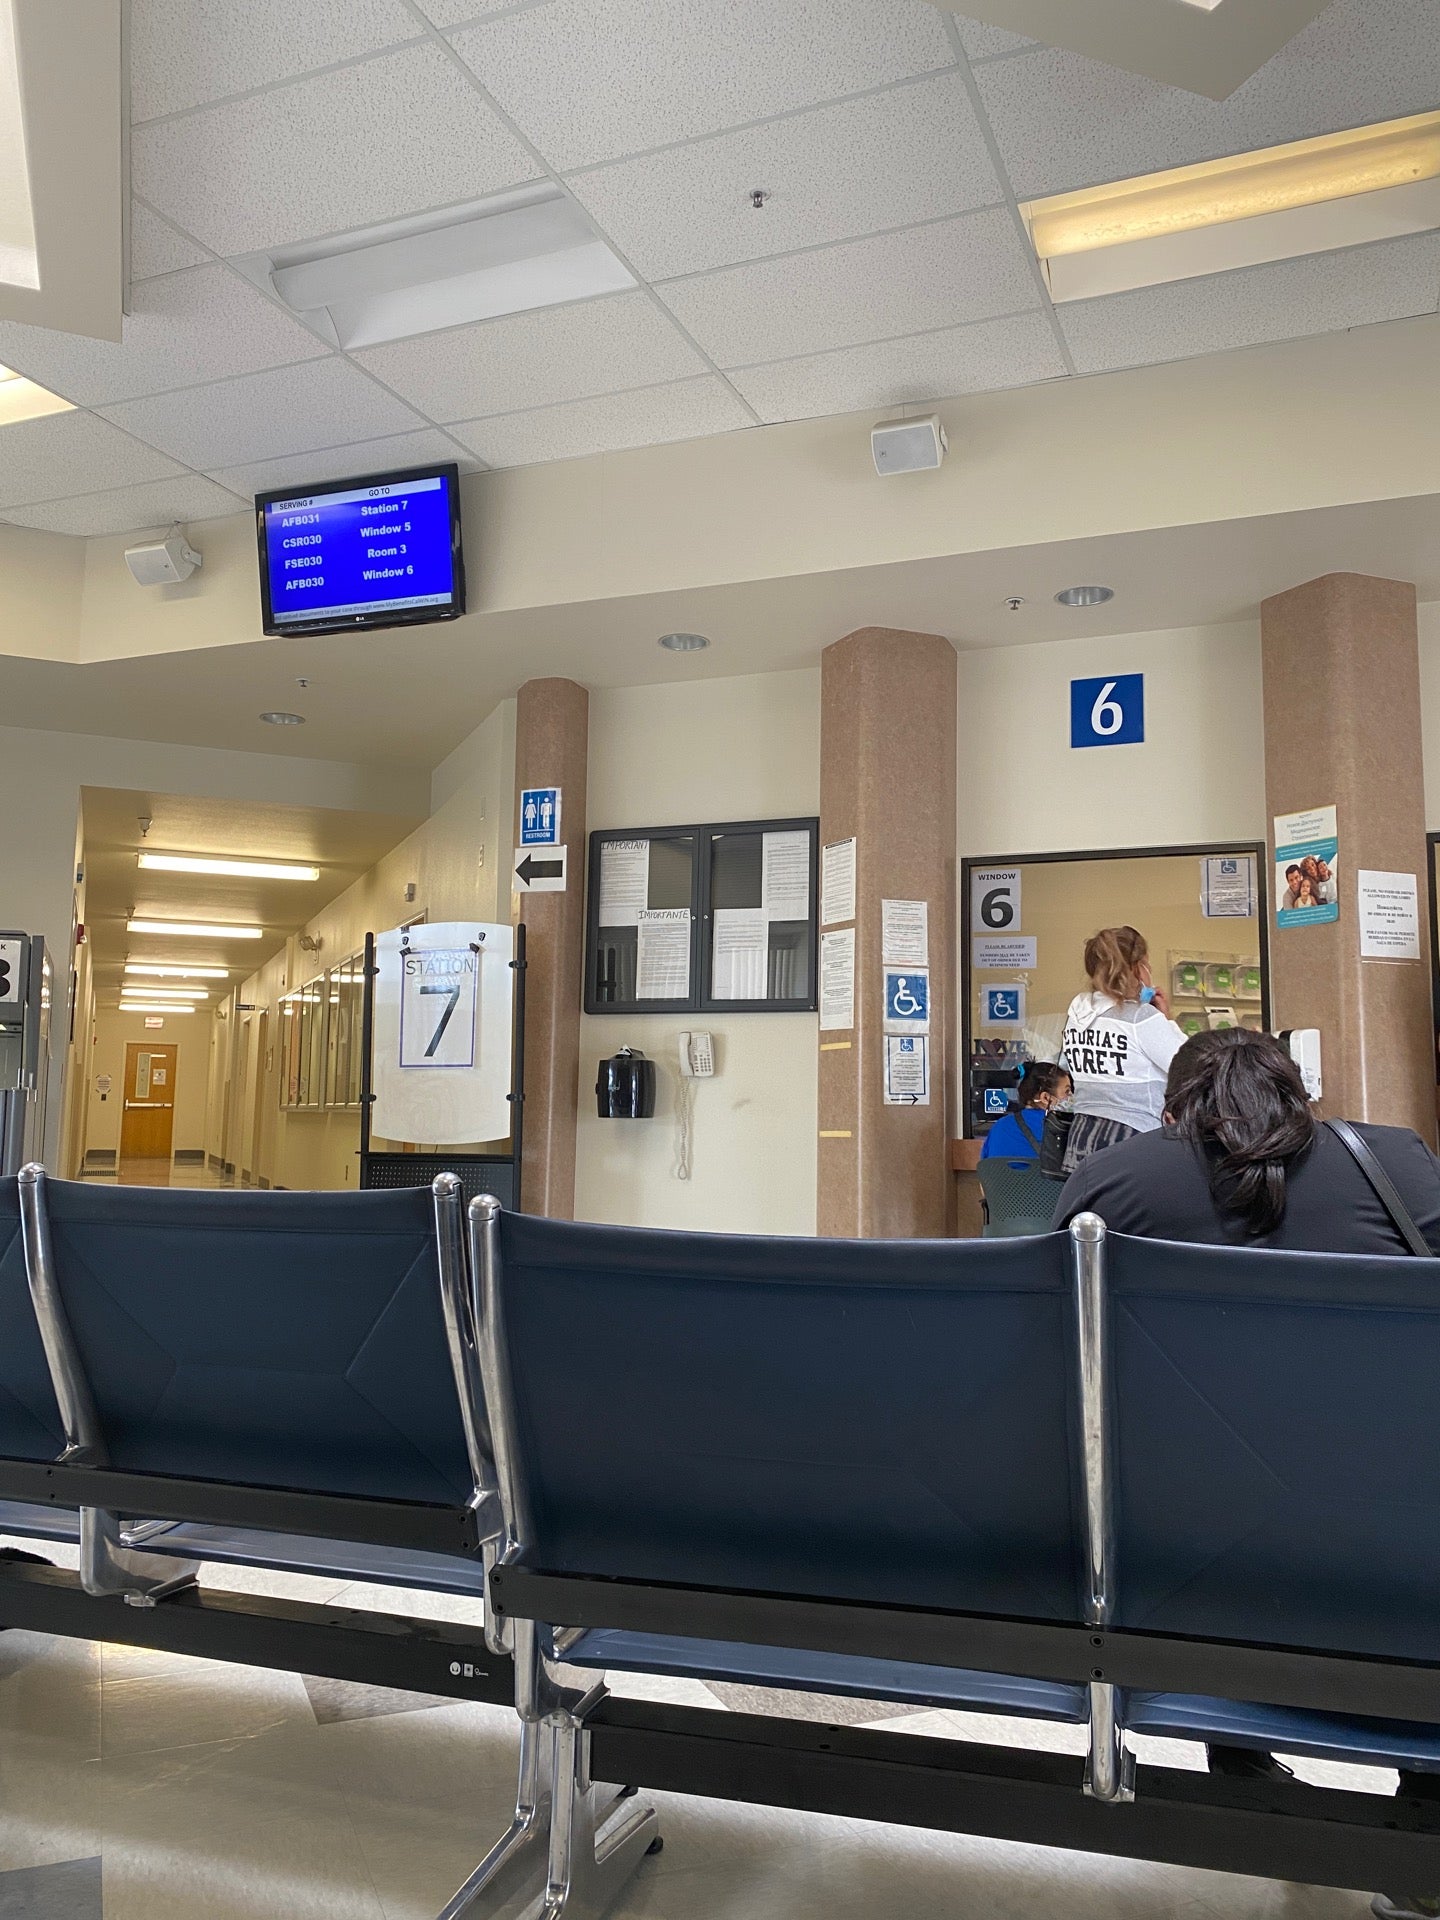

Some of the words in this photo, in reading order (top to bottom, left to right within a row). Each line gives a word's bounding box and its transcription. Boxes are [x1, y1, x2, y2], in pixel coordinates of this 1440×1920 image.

[369, 488, 379, 496] GO
[280, 500, 308, 510] SERVING
[361, 504, 398, 516] Station
[401, 500, 408, 510] 7
[282, 514, 320, 528] AFB031
[360, 525, 401, 538] Window
[404, 521, 411, 531] 5
[282, 534, 322, 548] CSR030
[367, 548, 397, 558] Room
[400, 544, 407, 554] 3
[284, 556, 322, 570] FSE030
[363, 568, 404, 580] Window
[406, 565, 413, 575] 6
[286, 576, 324, 590] AFB030
[1091, 682, 1123, 736] 6
[601, 840, 648, 850] IMPORTANT
[638, 910, 688, 920] IMPORTANTE
[981, 888, 1014, 928] 6
[406, 958, 474, 976] STATION
[420, 985, 460, 1057] 7
